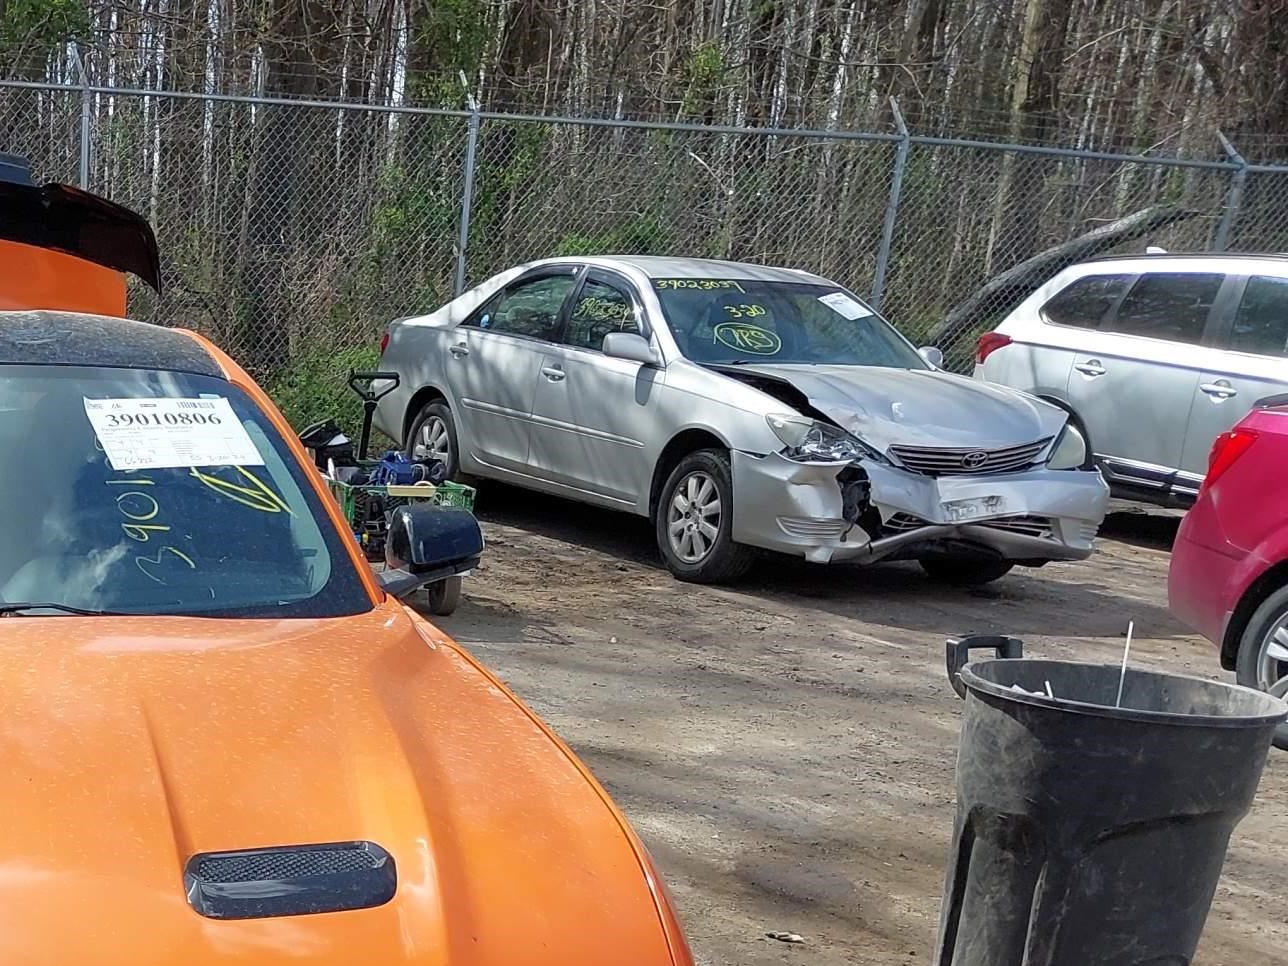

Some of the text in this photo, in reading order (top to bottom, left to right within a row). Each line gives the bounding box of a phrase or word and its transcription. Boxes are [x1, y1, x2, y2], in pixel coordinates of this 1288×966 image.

[723, 303, 766, 319] 3-20
[104, 412, 222, 428] 39010806
[102, 458, 196, 585] 3901
